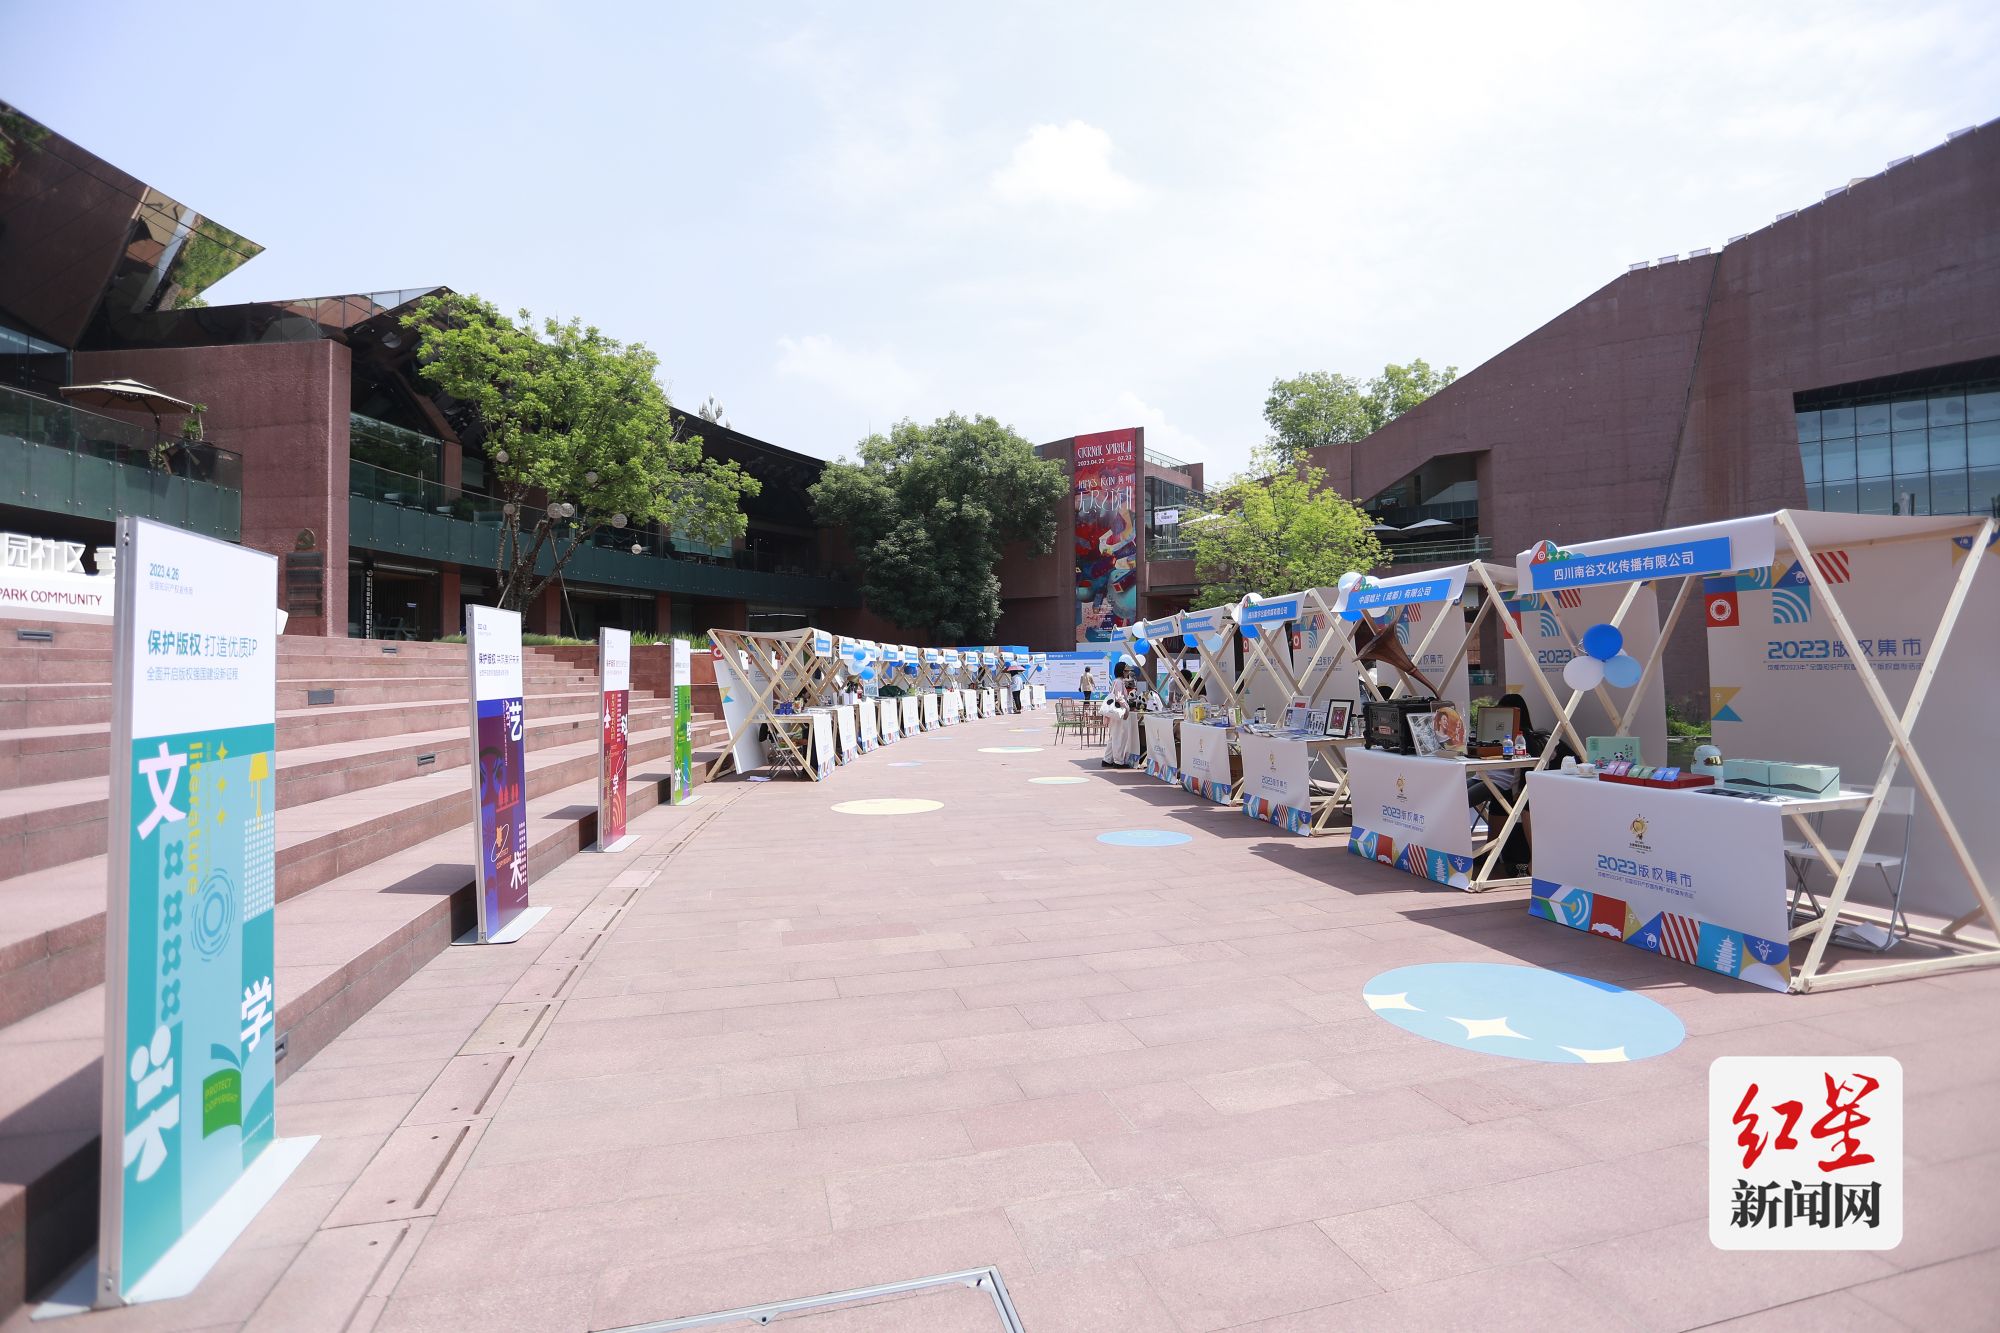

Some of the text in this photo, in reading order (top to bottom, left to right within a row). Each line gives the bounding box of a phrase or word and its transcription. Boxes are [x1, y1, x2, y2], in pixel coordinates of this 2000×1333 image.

[1077, 458, 1105, 467] 2023.04.22
[1553, 550, 1694, 581] 四川南谷文化传播有限公司
[31, 590, 102, 606] COMMUNITY
[147, 629, 258, 658] 保护版权 打造优质IP
[509, 700, 523, 742] 艺
[137, 741, 188, 841] 文
[510, 850, 523, 890] 术
[1597, 854, 1692, 888] 2023版权集市
[240, 976, 273, 1053] 学
